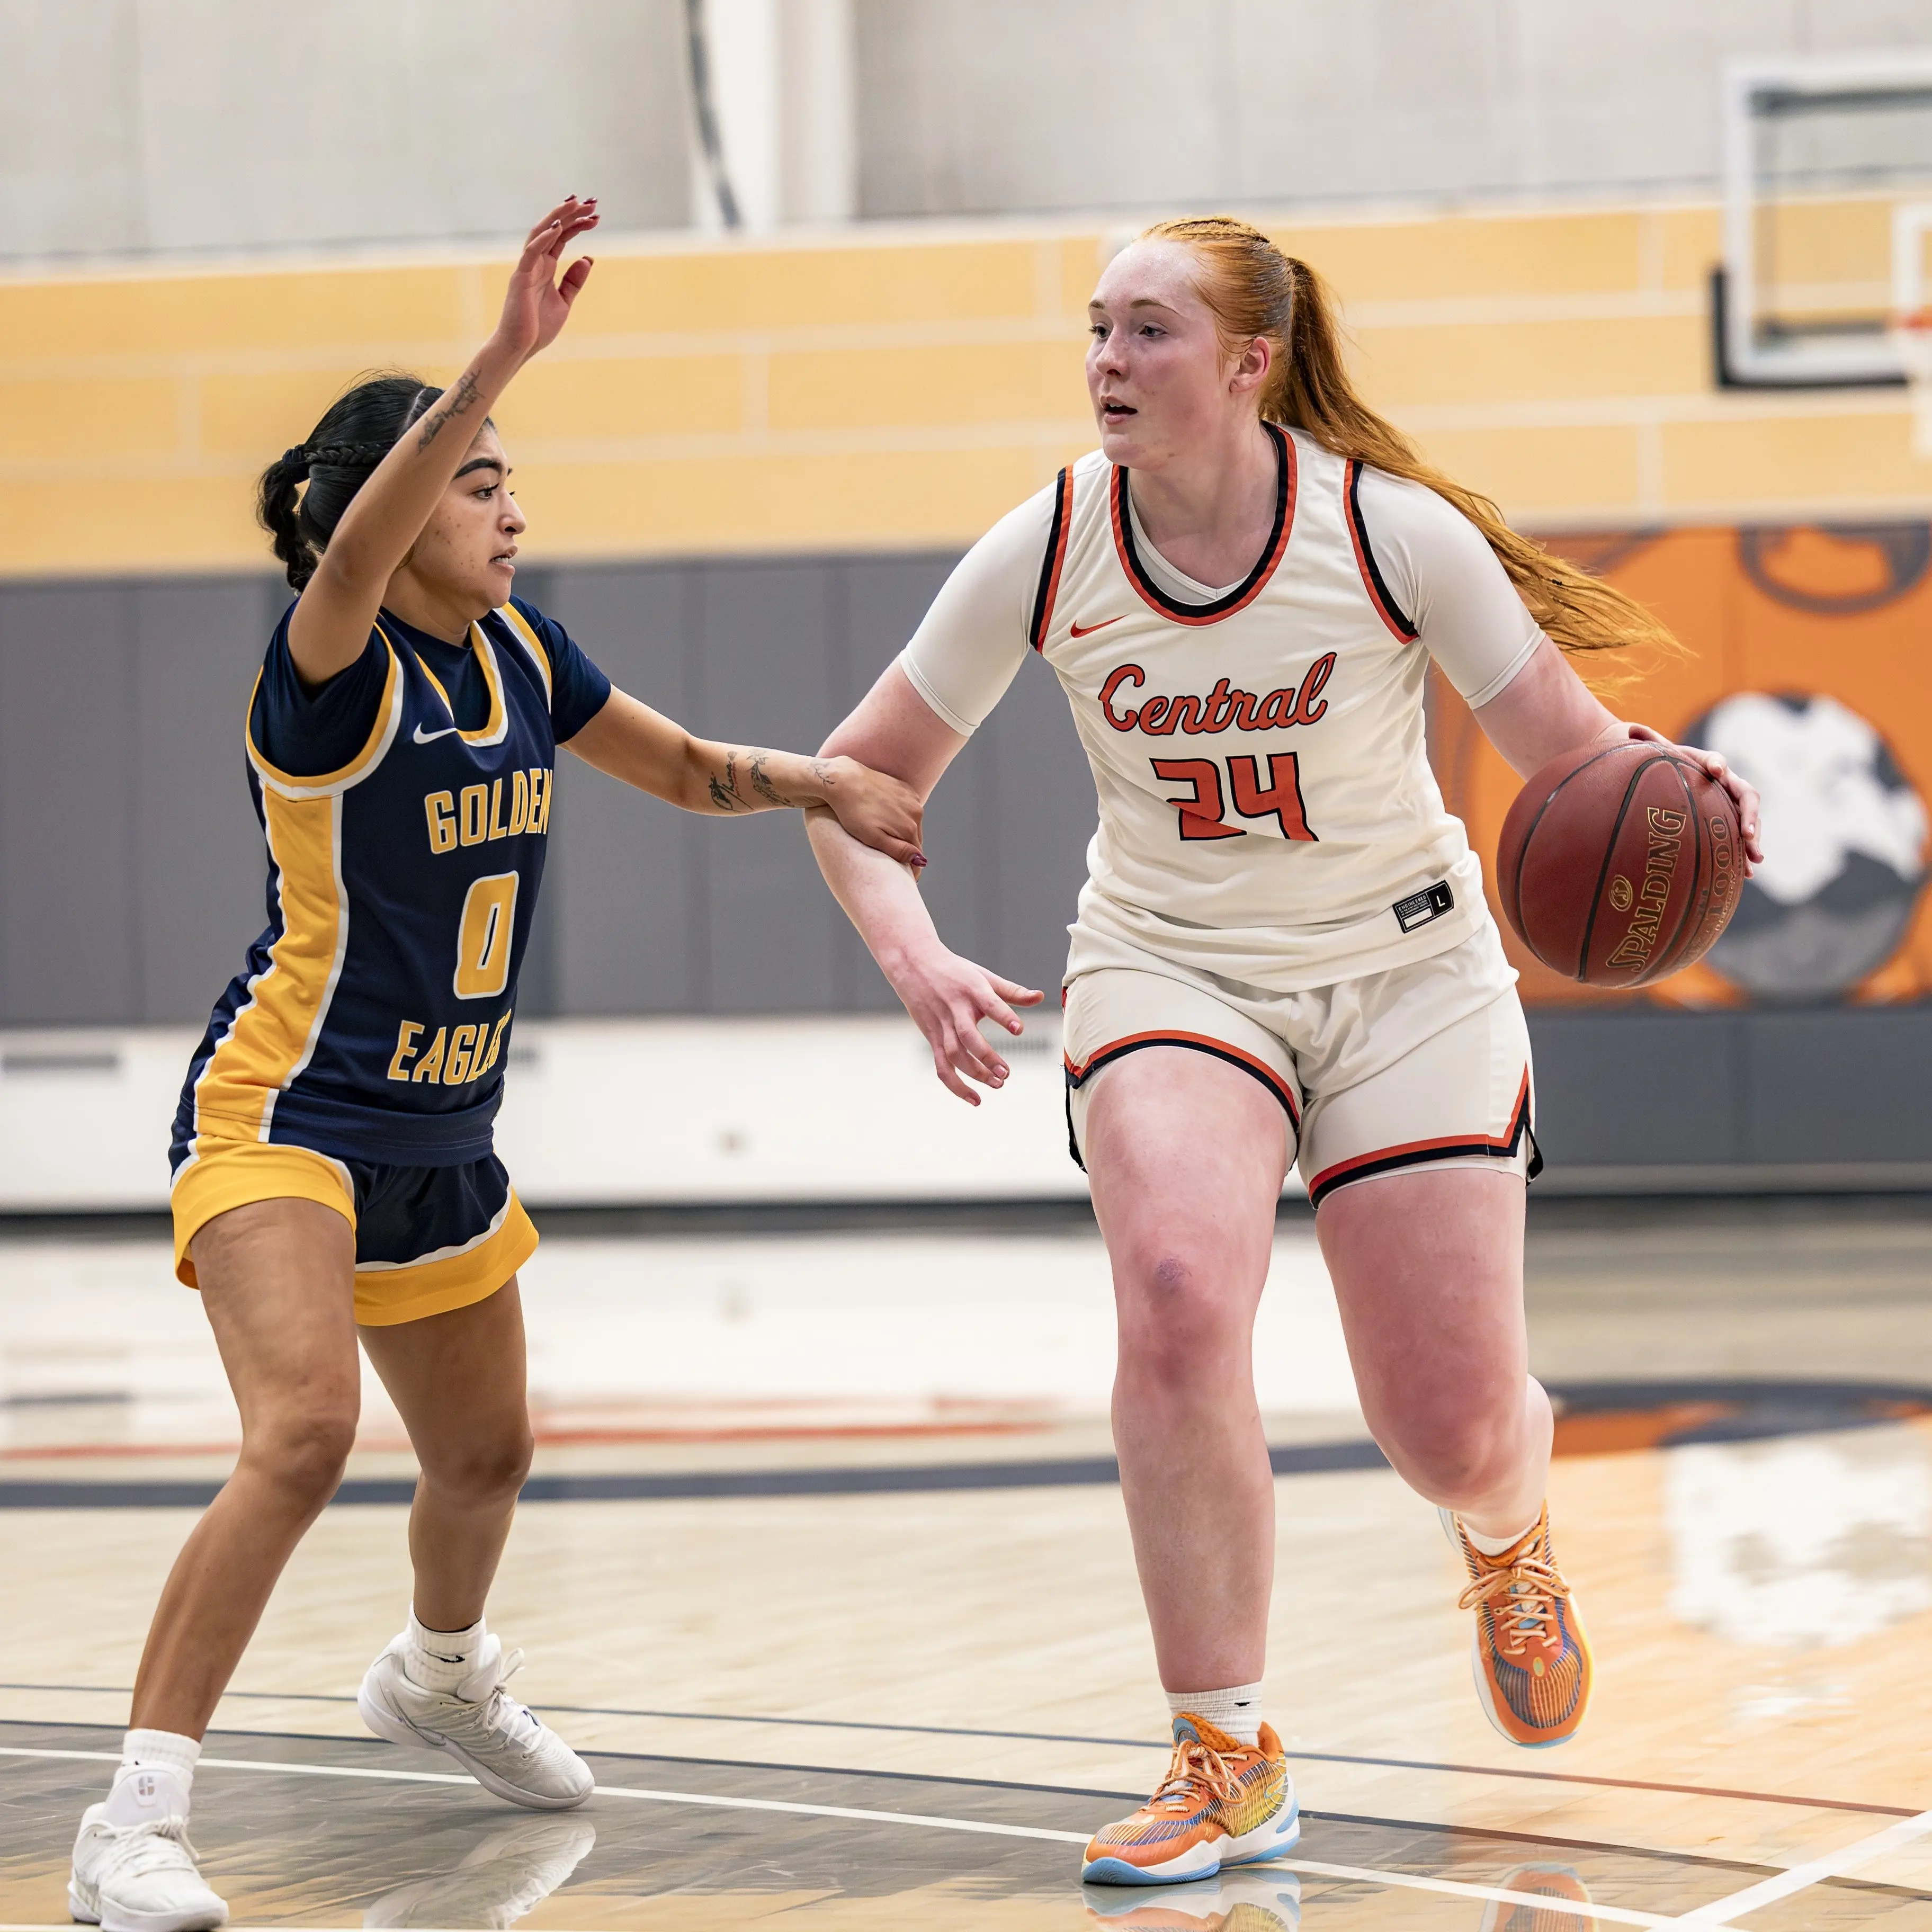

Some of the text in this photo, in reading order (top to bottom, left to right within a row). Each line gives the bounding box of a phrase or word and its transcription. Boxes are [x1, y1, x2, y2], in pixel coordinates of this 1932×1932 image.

[1098, 652, 1337, 736] Central
[424, 768, 552, 854] GOLDEN
[1149, 752, 1320, 842] 24
[1436, 896, 1445, 907] L
[1606, 807, 1687, 972] SPALDING
[453, 870, 518, 999] 0
